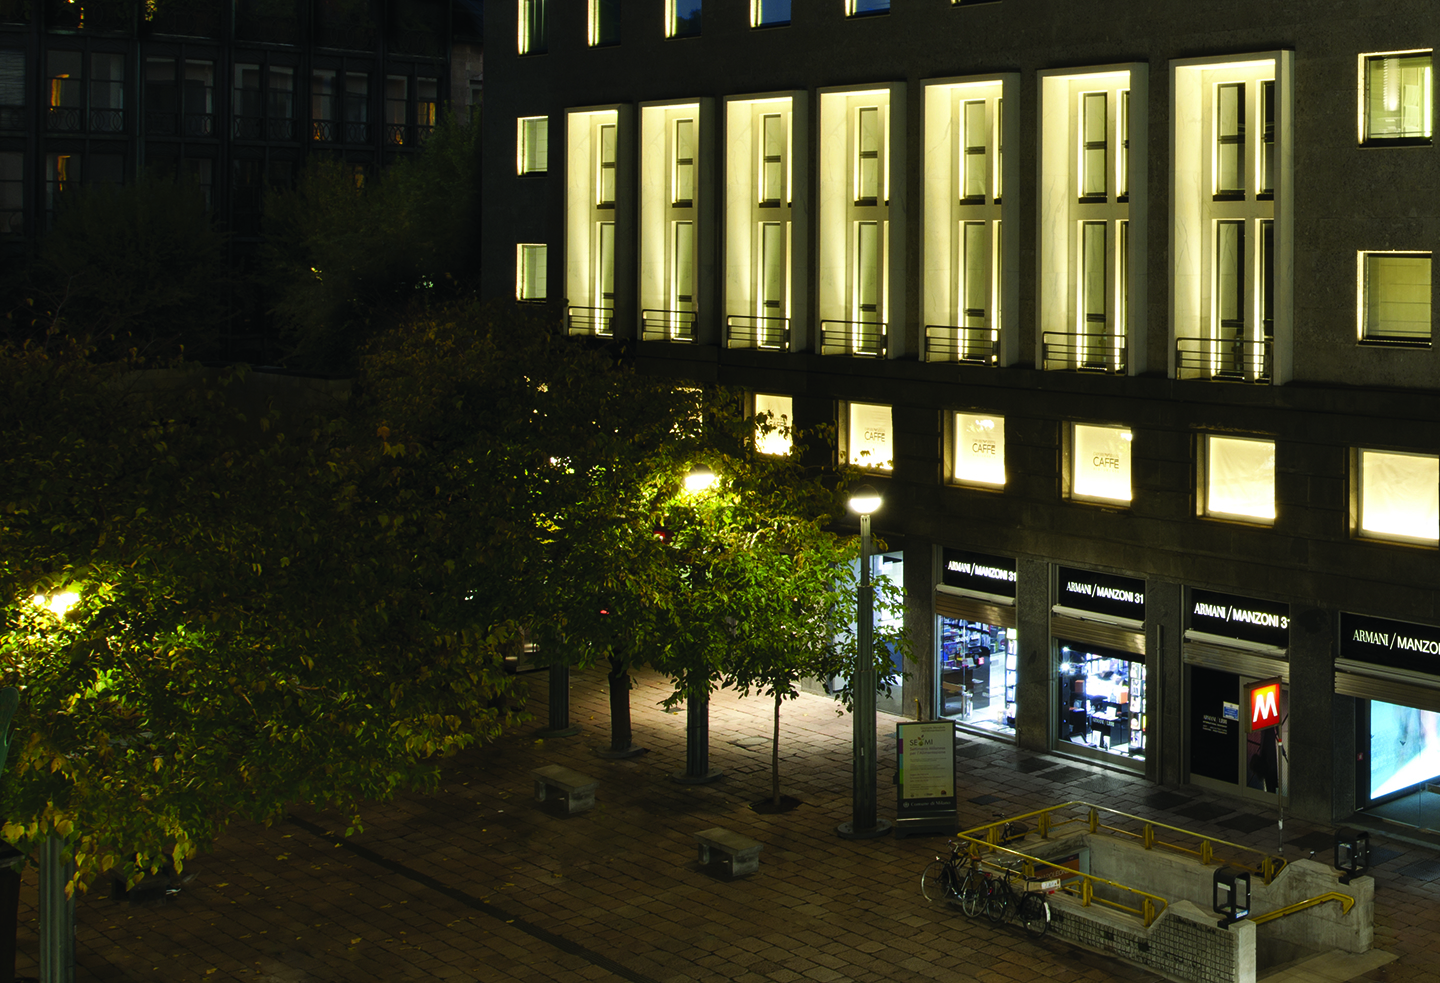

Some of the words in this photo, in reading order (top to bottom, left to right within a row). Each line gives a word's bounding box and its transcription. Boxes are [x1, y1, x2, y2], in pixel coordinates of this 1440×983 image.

[1008, 570, 1017, 582] 31
[1134, 592, 1144, 605] 31
[1280, 616, 1290, 629] 3
[1253, 691, 1278, 722] M
